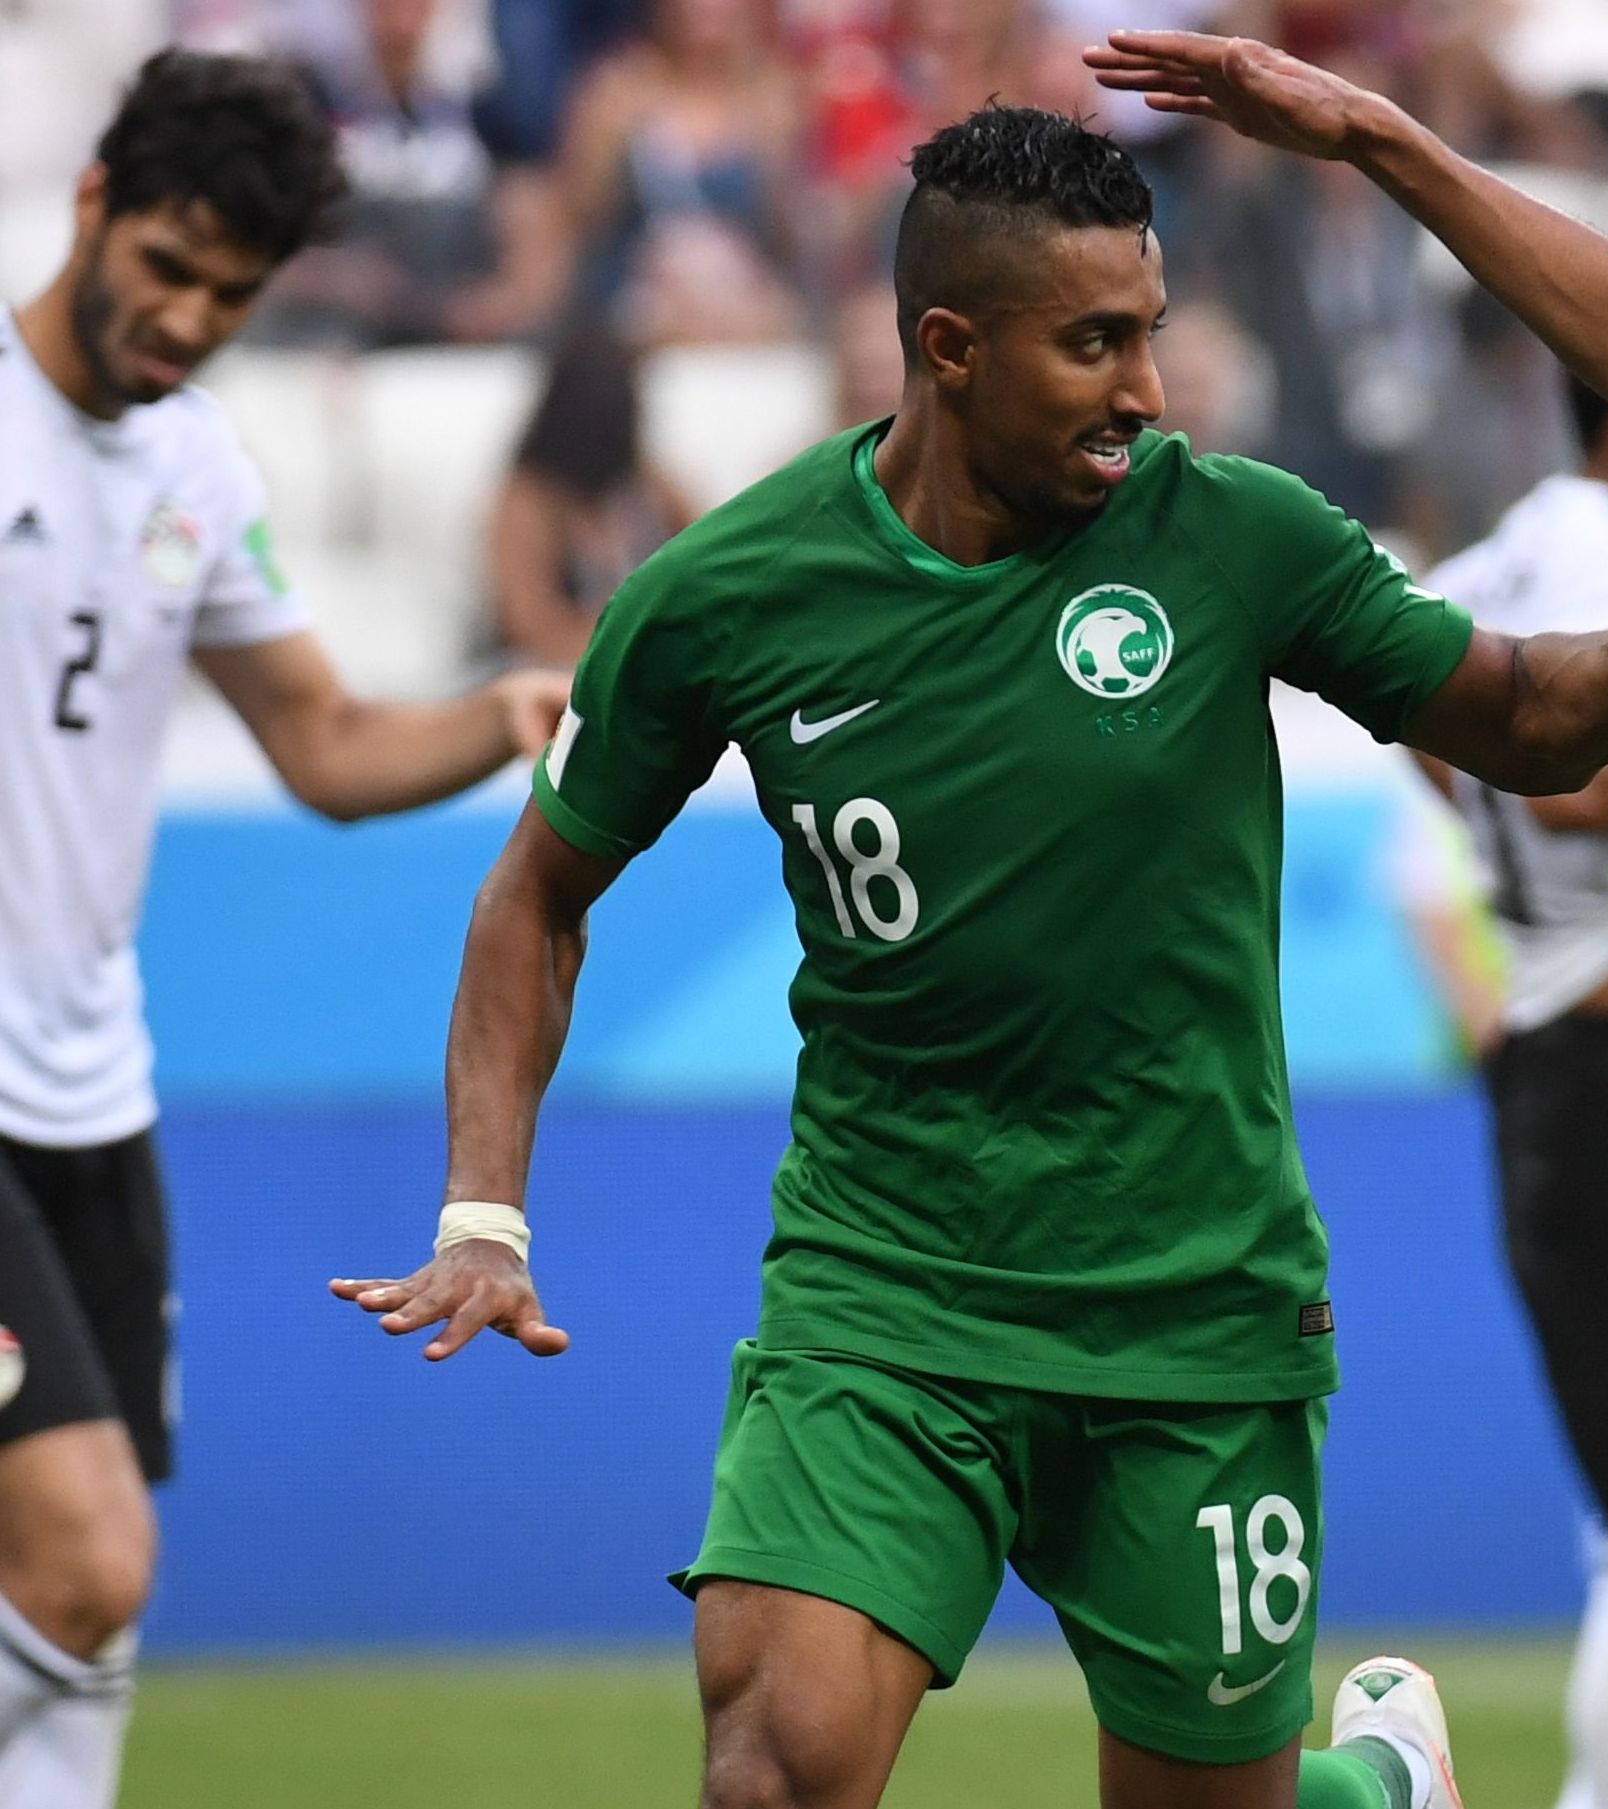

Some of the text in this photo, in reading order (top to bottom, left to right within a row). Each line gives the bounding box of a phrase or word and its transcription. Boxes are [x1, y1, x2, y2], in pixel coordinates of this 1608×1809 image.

[1122, 647, 1155, 663] SAFF
[792, 797, 919, 942] 18
[1195, 1494, 1312, 1655] 18
